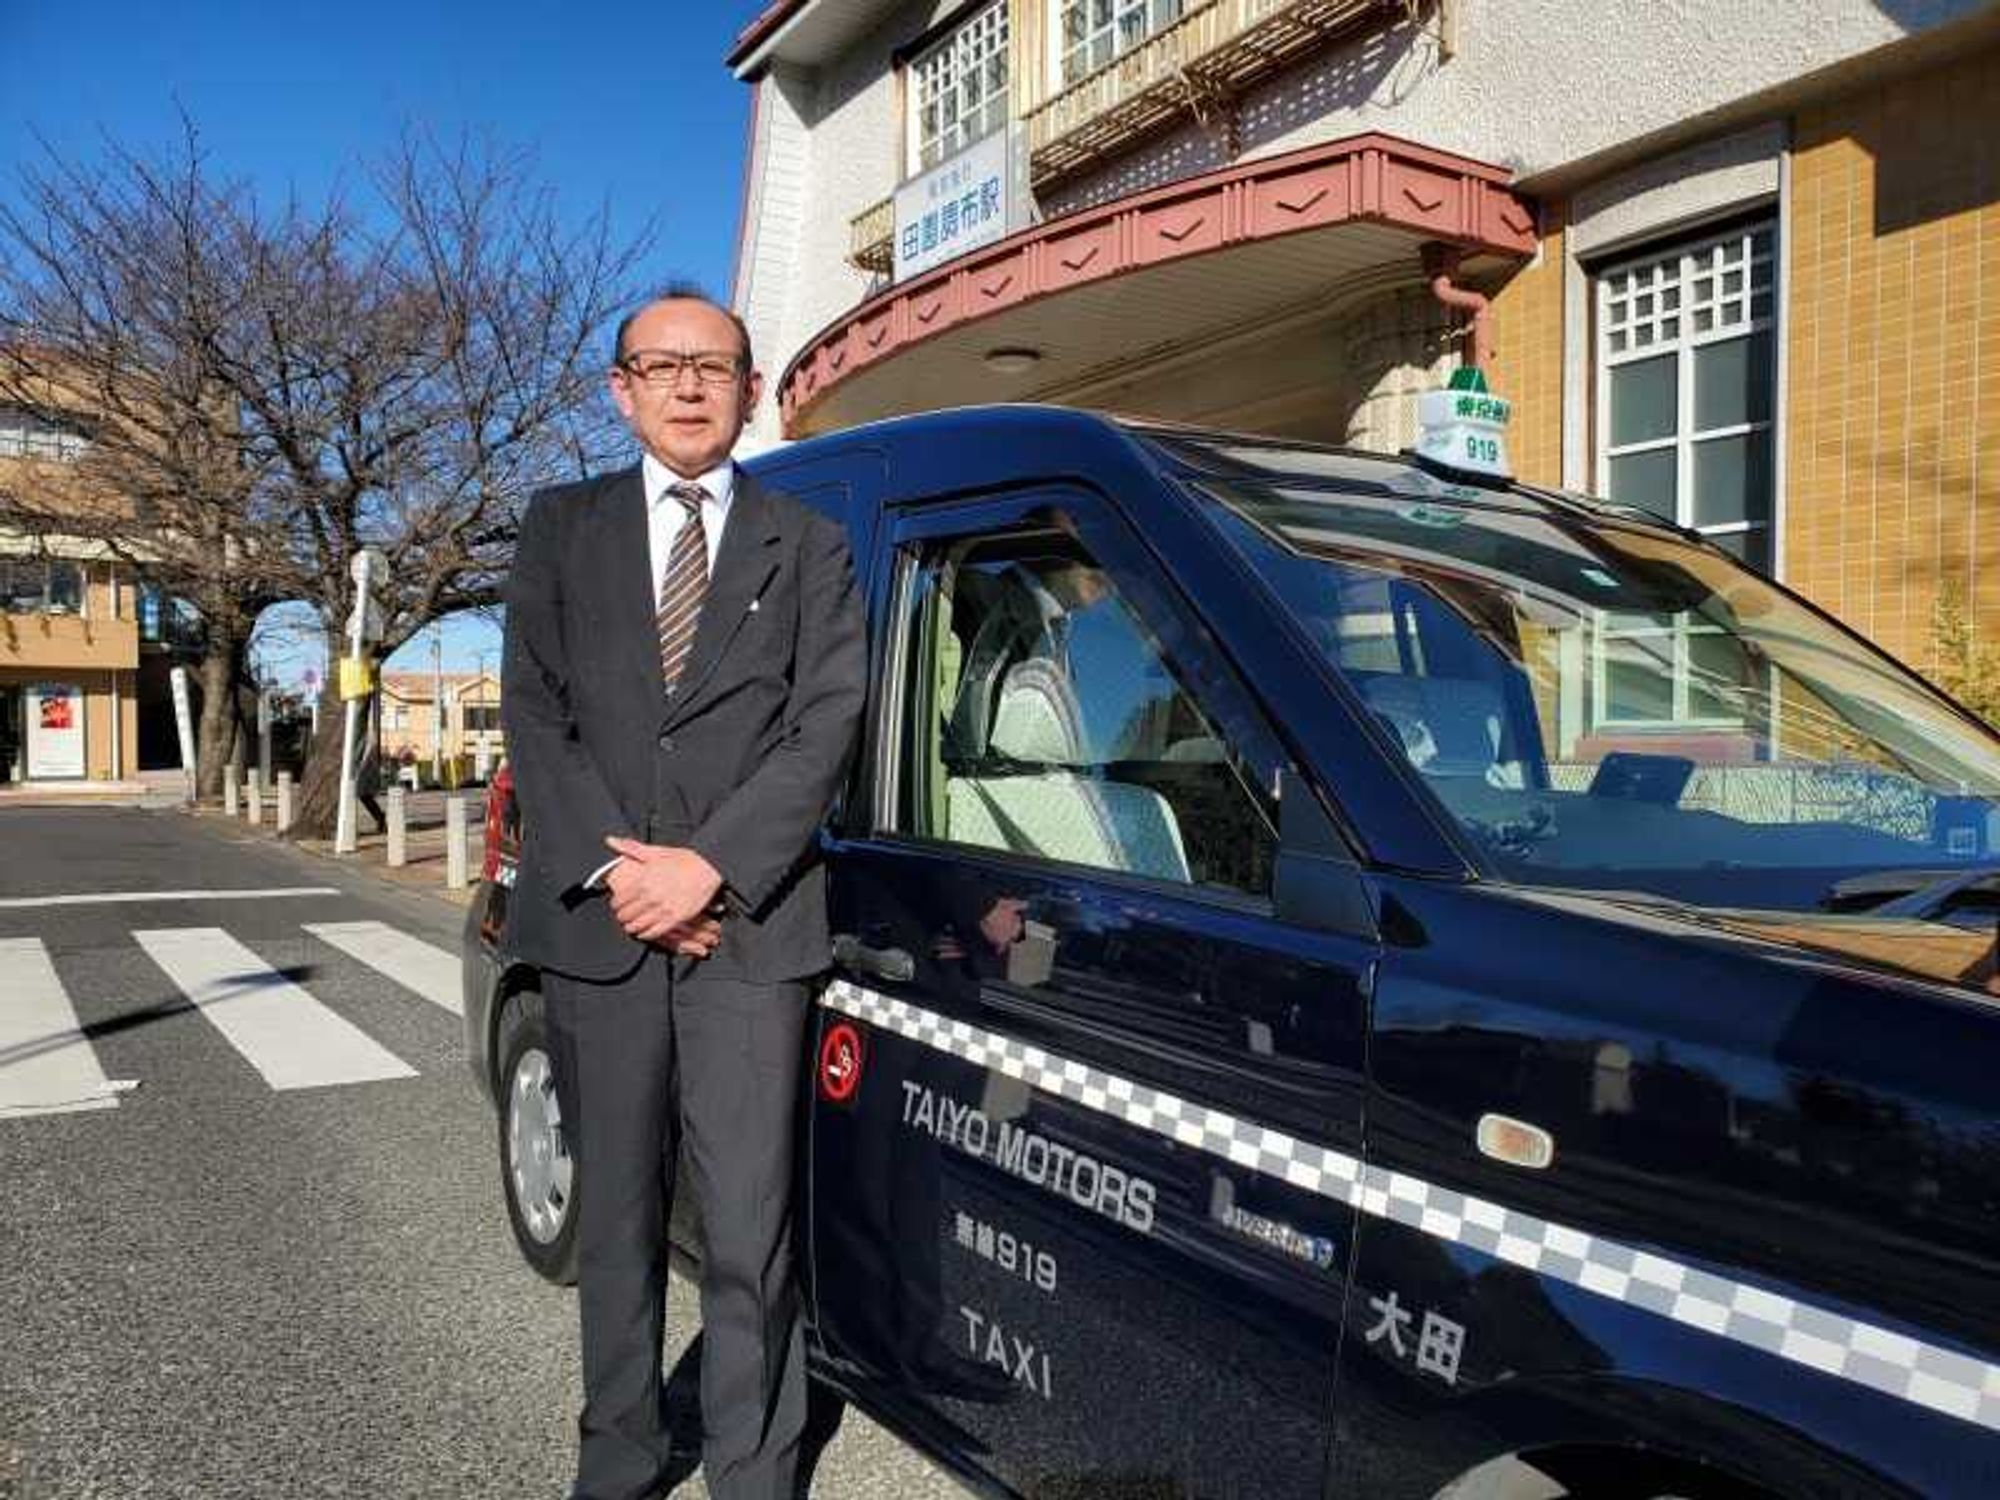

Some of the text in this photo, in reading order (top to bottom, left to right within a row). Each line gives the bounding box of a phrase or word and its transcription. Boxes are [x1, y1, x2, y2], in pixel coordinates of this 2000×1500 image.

[1467, 436, 1498, 462] 919
[902, 1080, 1157, 1232] TAIYO MOTORS
[960, 1306, 1052, 1400] TAXI
[1365, 1292, 1466, 1386] 大田
